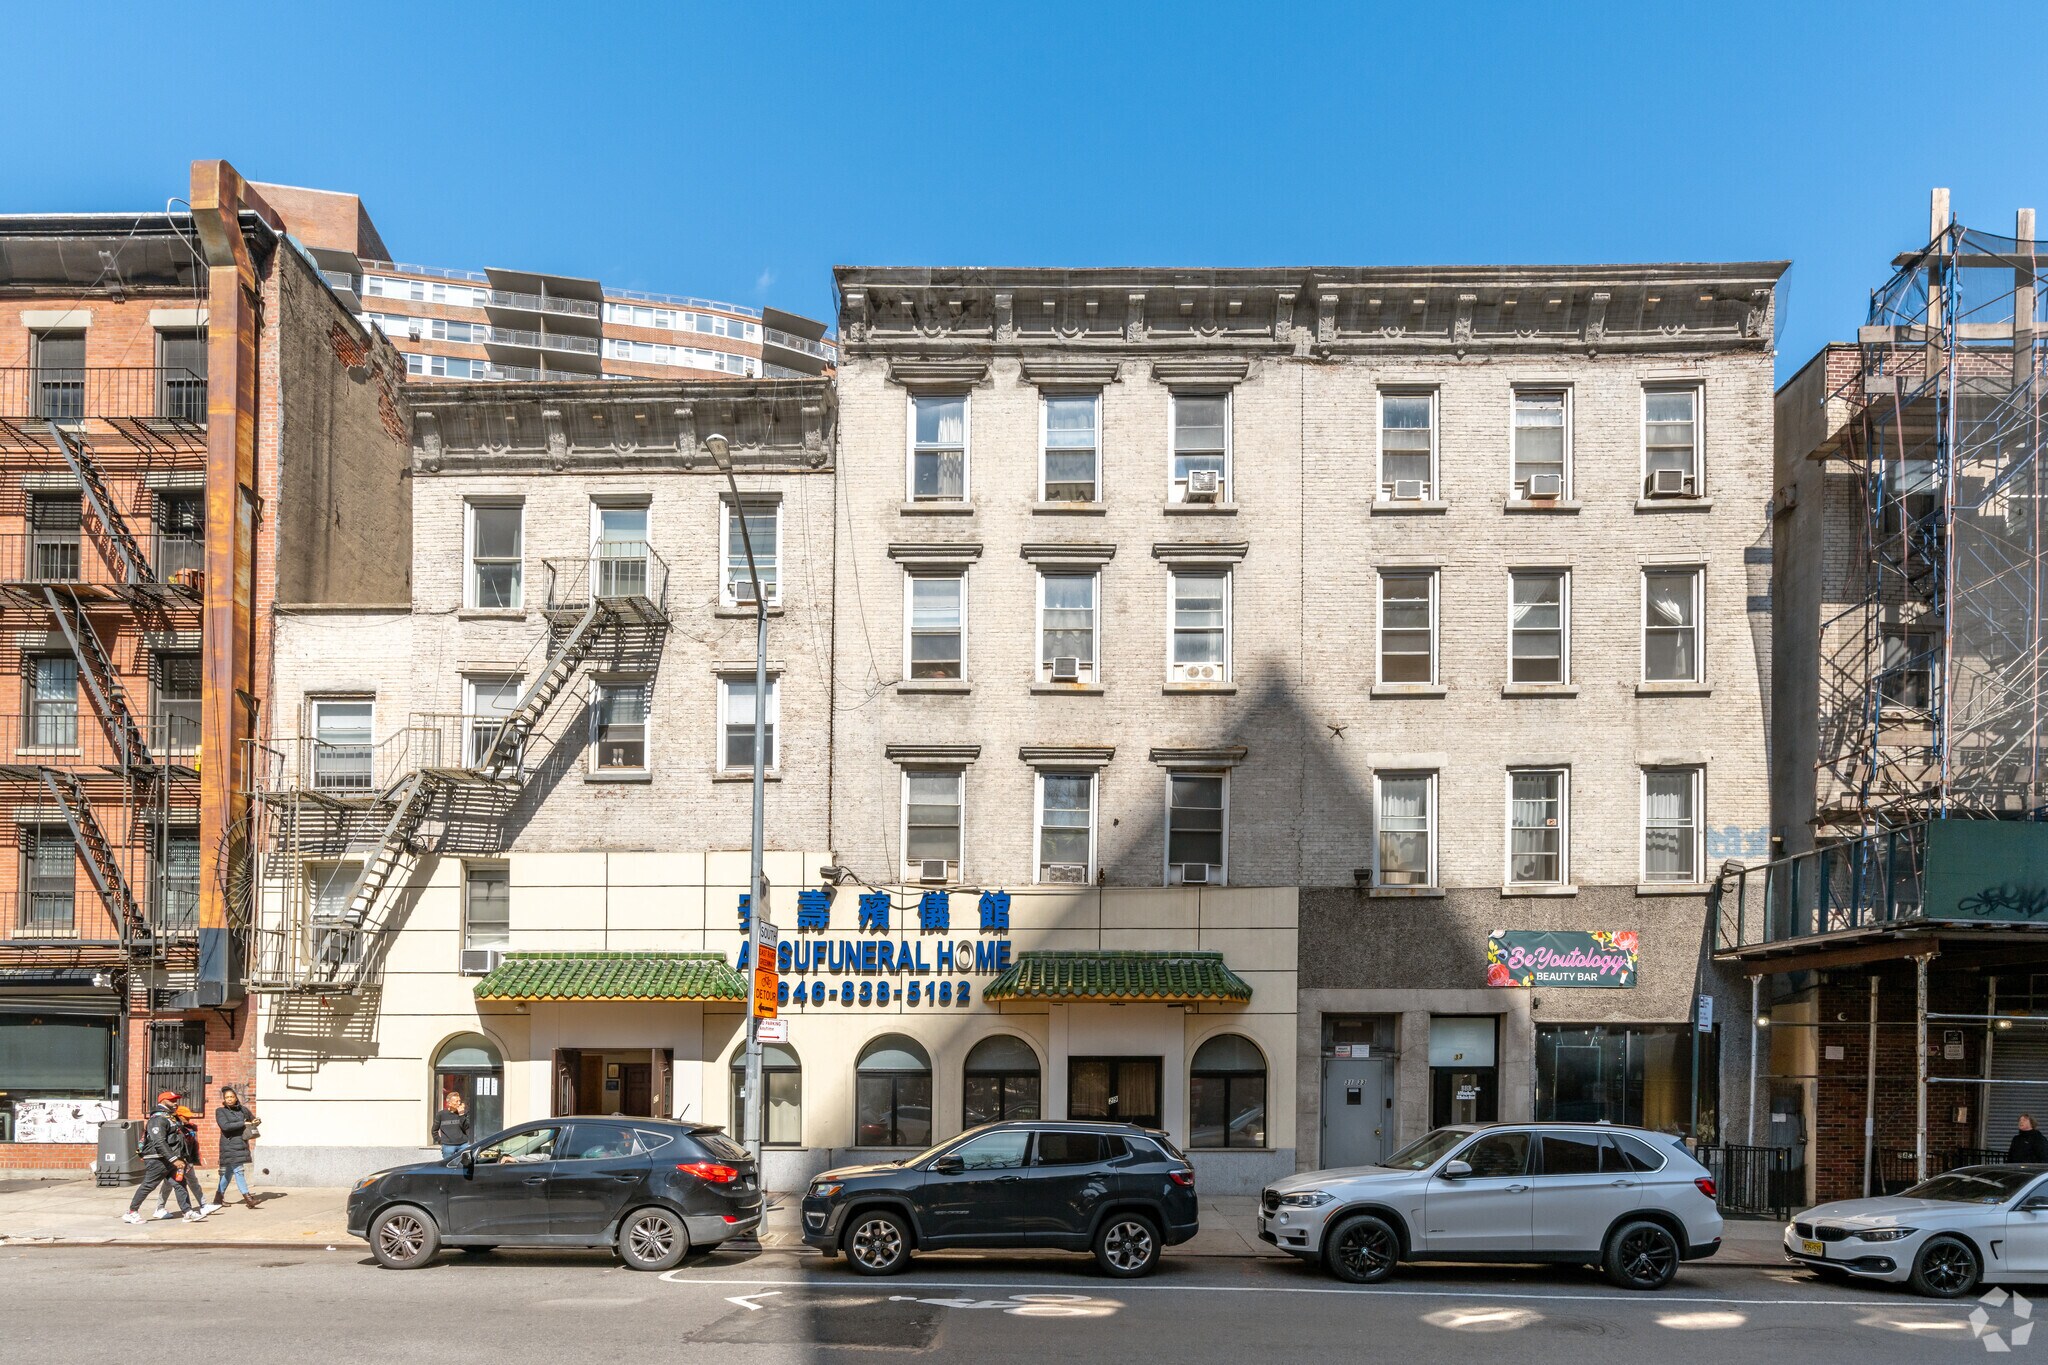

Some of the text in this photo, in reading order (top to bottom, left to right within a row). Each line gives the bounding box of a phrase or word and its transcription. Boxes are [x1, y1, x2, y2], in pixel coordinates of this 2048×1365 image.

[760, 925, 776, 941] SOUTH
[937, 940, 1011, 969] HOME
[1508, 946, 1627, 976] BeYoutology
[1536, 972, 1598, 981] BEAUTY BAR
[755, 988, 777, 1001] DETOUR
[777, 981, 970, 1000] 646-838-5182
